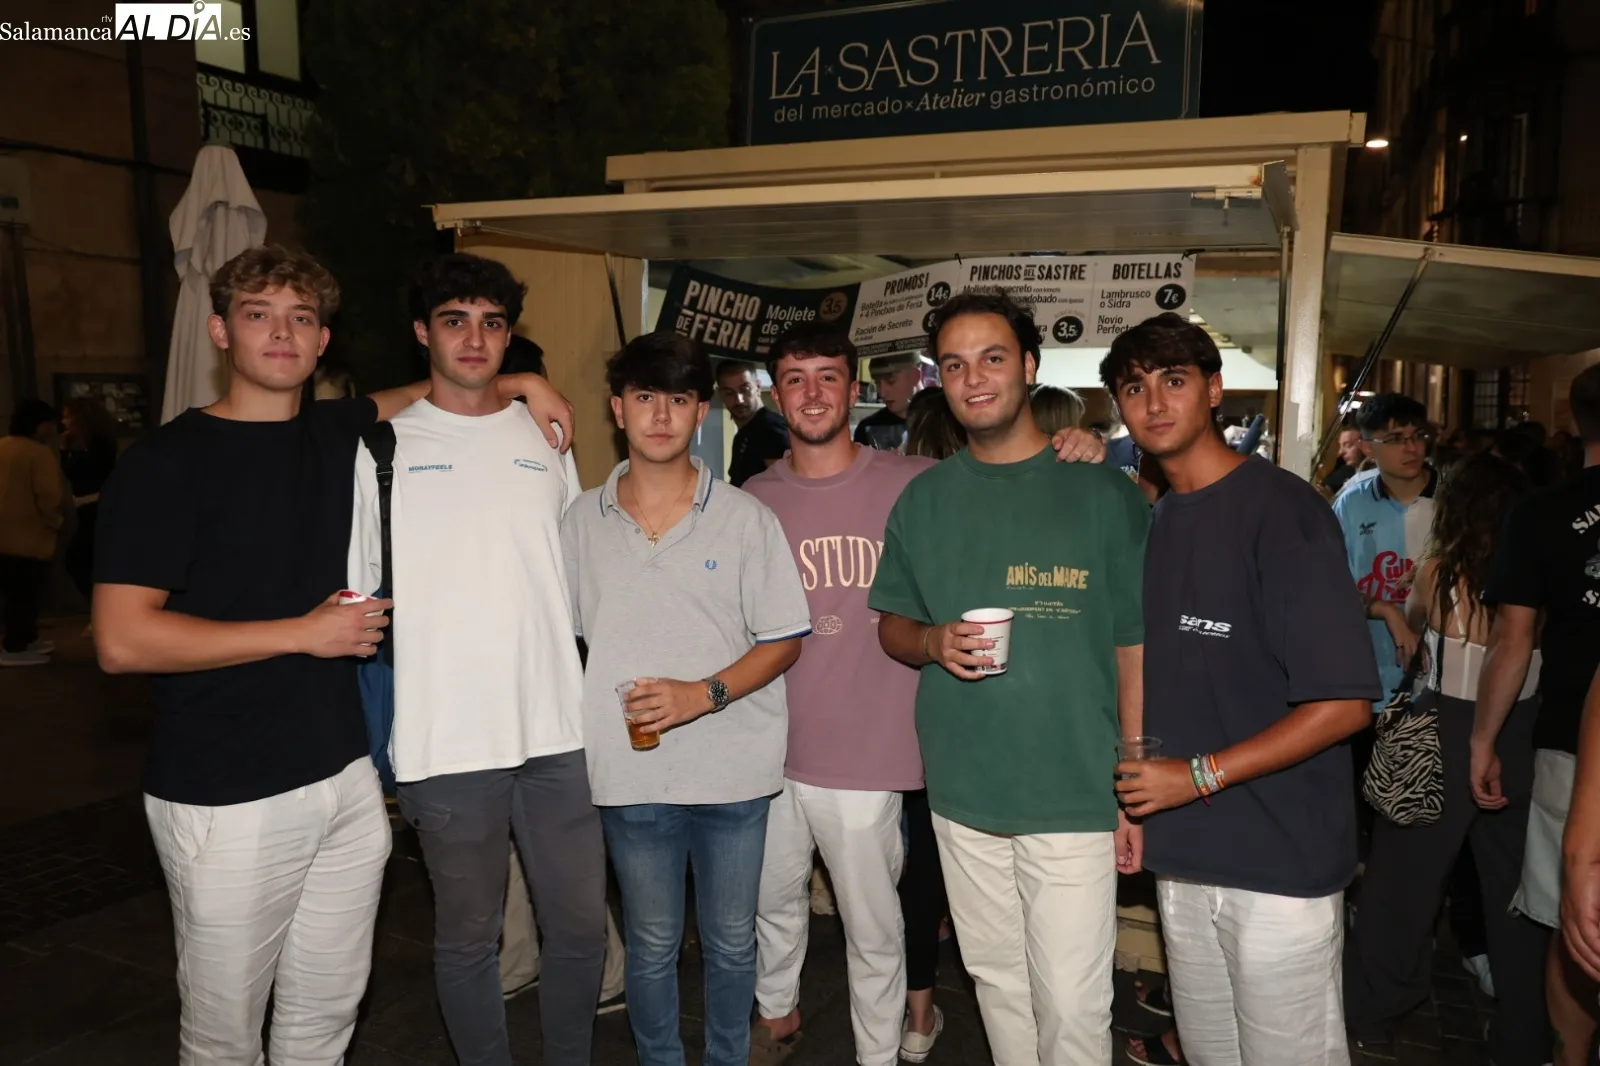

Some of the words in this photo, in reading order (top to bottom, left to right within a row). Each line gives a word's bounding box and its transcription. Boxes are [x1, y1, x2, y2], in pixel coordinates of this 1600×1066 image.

[769, 47, 821, 100] LA
[837, 10, 1162, 92] SASTRERIA
[774, 102, 803, 123] del
[812, 95, 902, 120] mercado
[915, 91, 985, 112] Atelier
[989, 75, 1156, 109] gastronómico
[970, 264, 1022, 282] PINCHOS
[1024, 267, 1035, 277] DEL
[1037, 264, 1087, 281] SASTRE
[1112, 262, 1182, 280] BOTELLAS
[883, 272, 930, 297] PROMOS!
[682, 279, 762, 322] PINCHO
[1101, 289, 1151, 299] Lambrusco
[1163, 288, 1179, 304] 7€
[860, 300, 883, 312] Botella
[871, 306, 896, 317] Pinchos
[1107, 298, 1131, 309] Sidra
[766, 304, 816, 322] Mollete
[1098, 315, 1123, 324] Novio
[675, 315, 692, 332] DE
[689, 313, 753, 353] FERIA
[761, 320, 779, 336] de
[878, 322, 887, 332] de
[887, 319, 914, 330] Secreto
[799, 535, 885, 591] STUD
[1038, 572, 1053, 587] DEL
